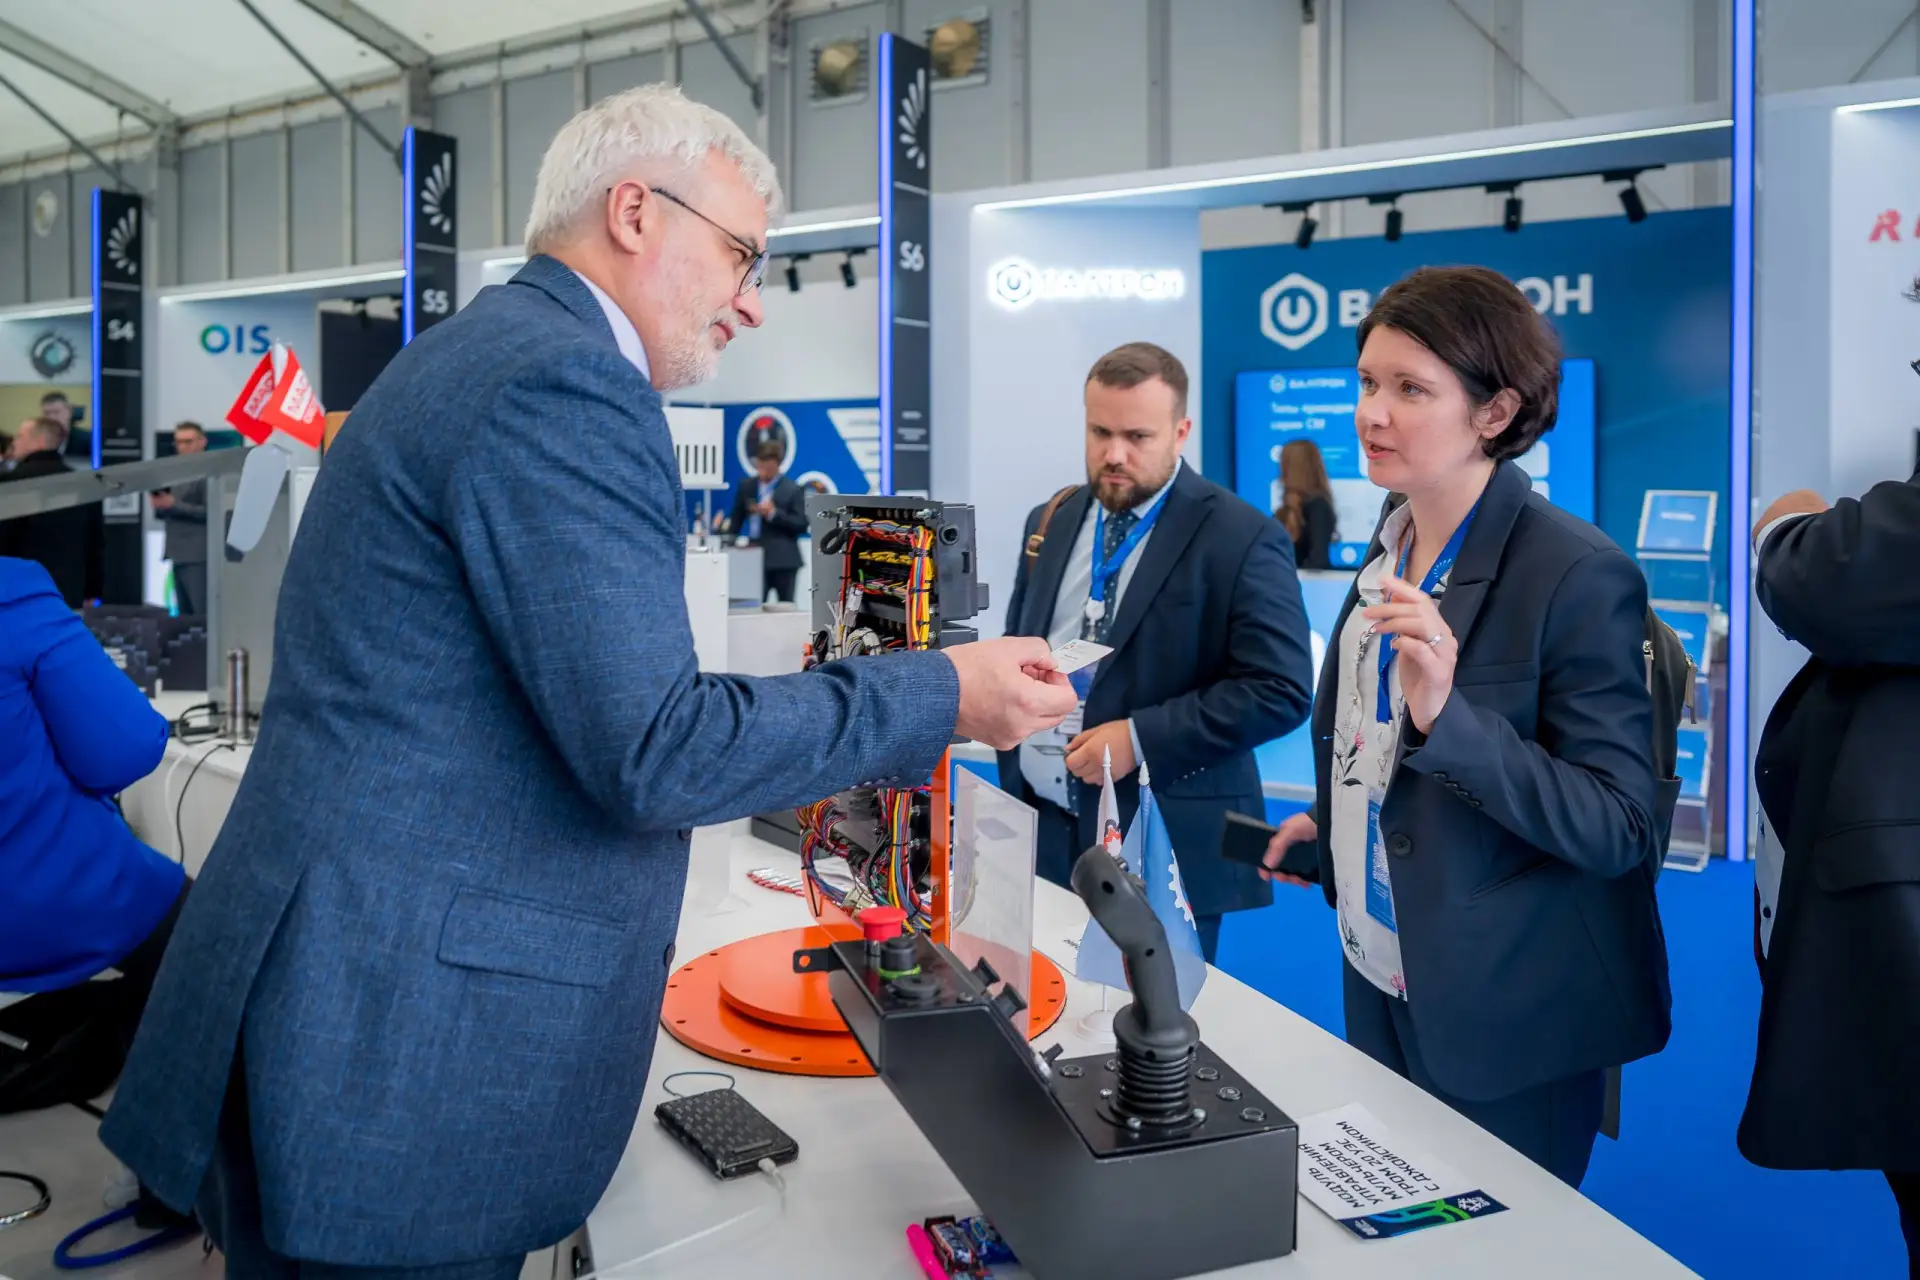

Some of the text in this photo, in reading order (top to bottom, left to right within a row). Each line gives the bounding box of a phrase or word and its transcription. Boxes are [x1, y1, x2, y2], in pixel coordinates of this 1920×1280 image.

[900, 240, 925, 272] S6
[422, 288, 449, 314] S5
[107, 319, 136, 341] S4
[200, 324, 272, 354] OIS
[1318, 1142, 1403, 1200] МУЛЬЧЕРОМ
[1336, 1120, 1440, 1191] С ДЖОЙСТИКОМ
[1361, 1155, 1383, 1167] 20
[1298, 1143, 1384, 1205] УПРАВЛЕНИЯ
[1308, 1166, 1365, 1208] МОДУЛЬ
[1378, 1167, 1420, 1196] ТРОМ
